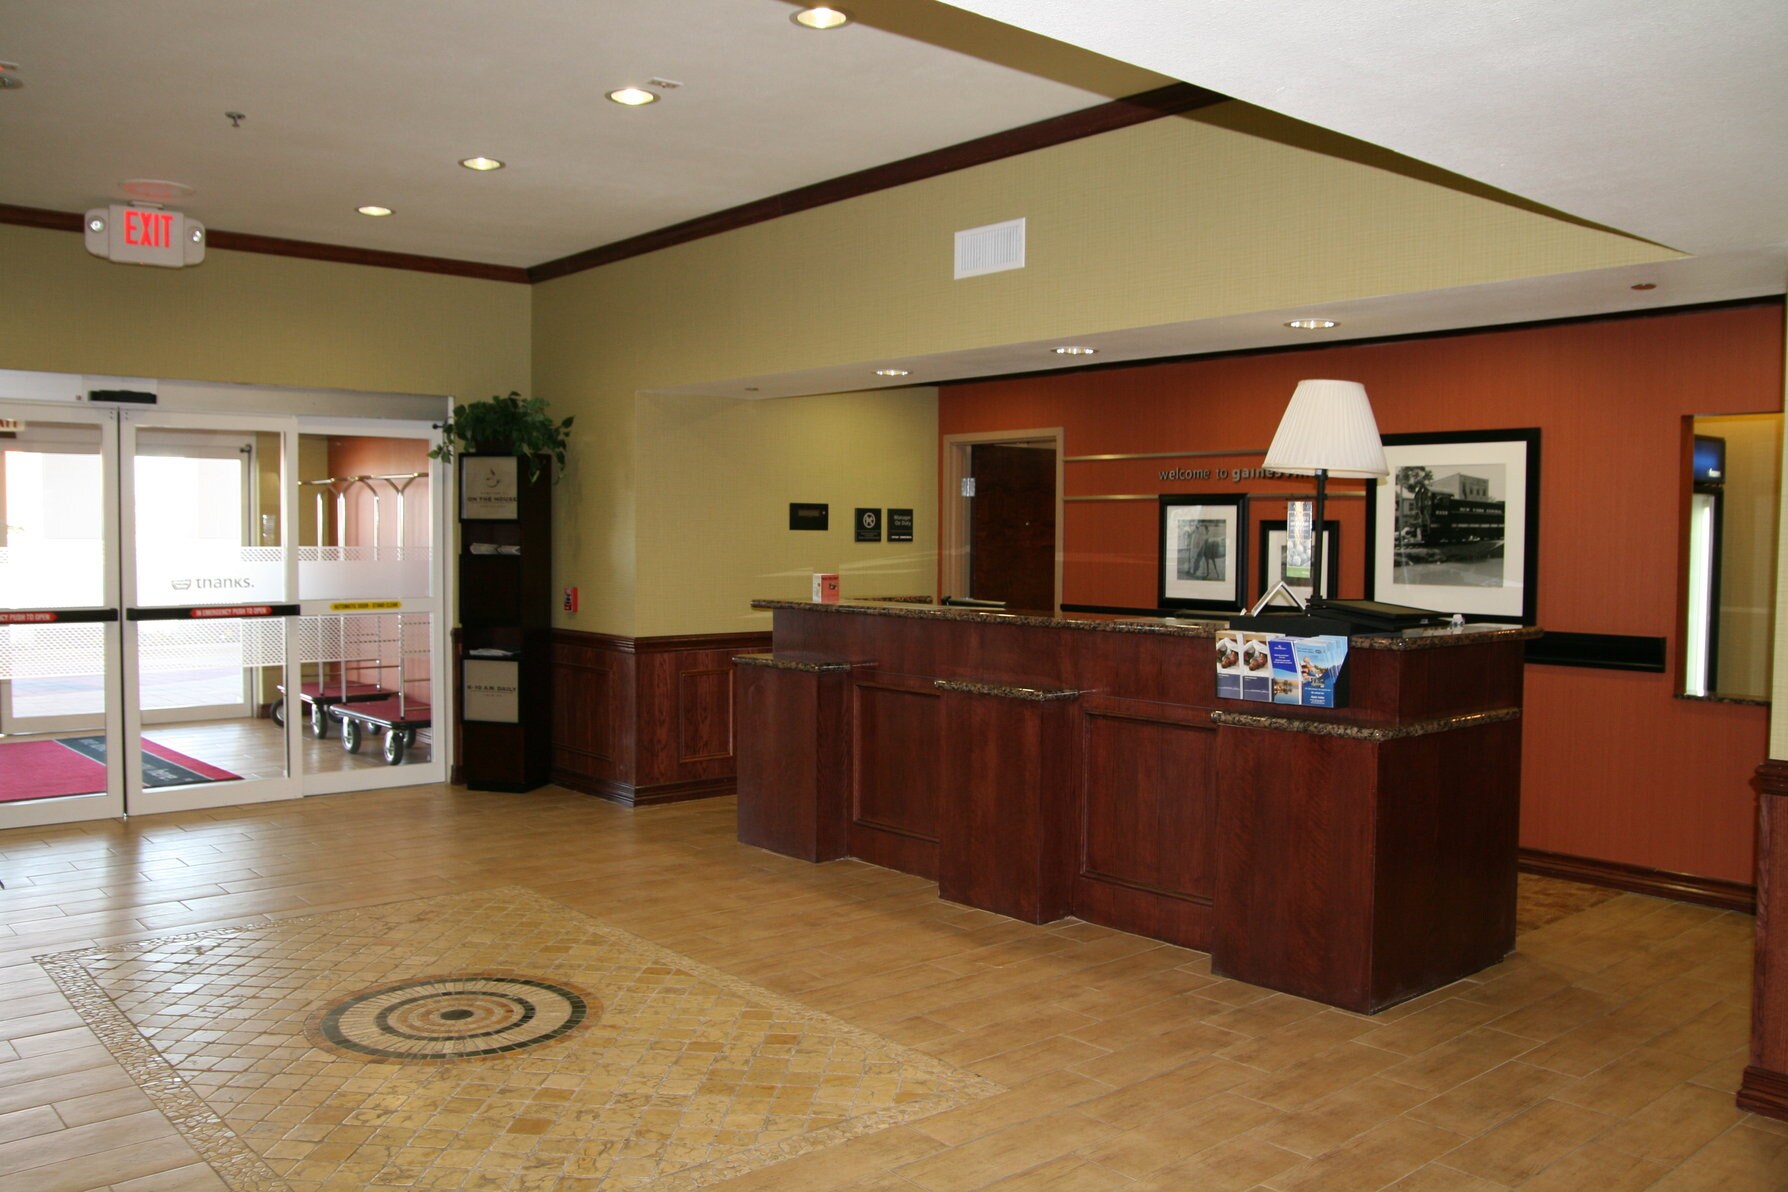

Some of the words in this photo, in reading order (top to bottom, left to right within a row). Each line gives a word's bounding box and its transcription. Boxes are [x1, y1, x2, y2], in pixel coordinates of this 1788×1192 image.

[124, 210, 174, 248] EXIT
[1159, 467, 1210, 481] welcome
[1216, 468, 1229, 479] to
[195, 577, 256, 590] thanks.
